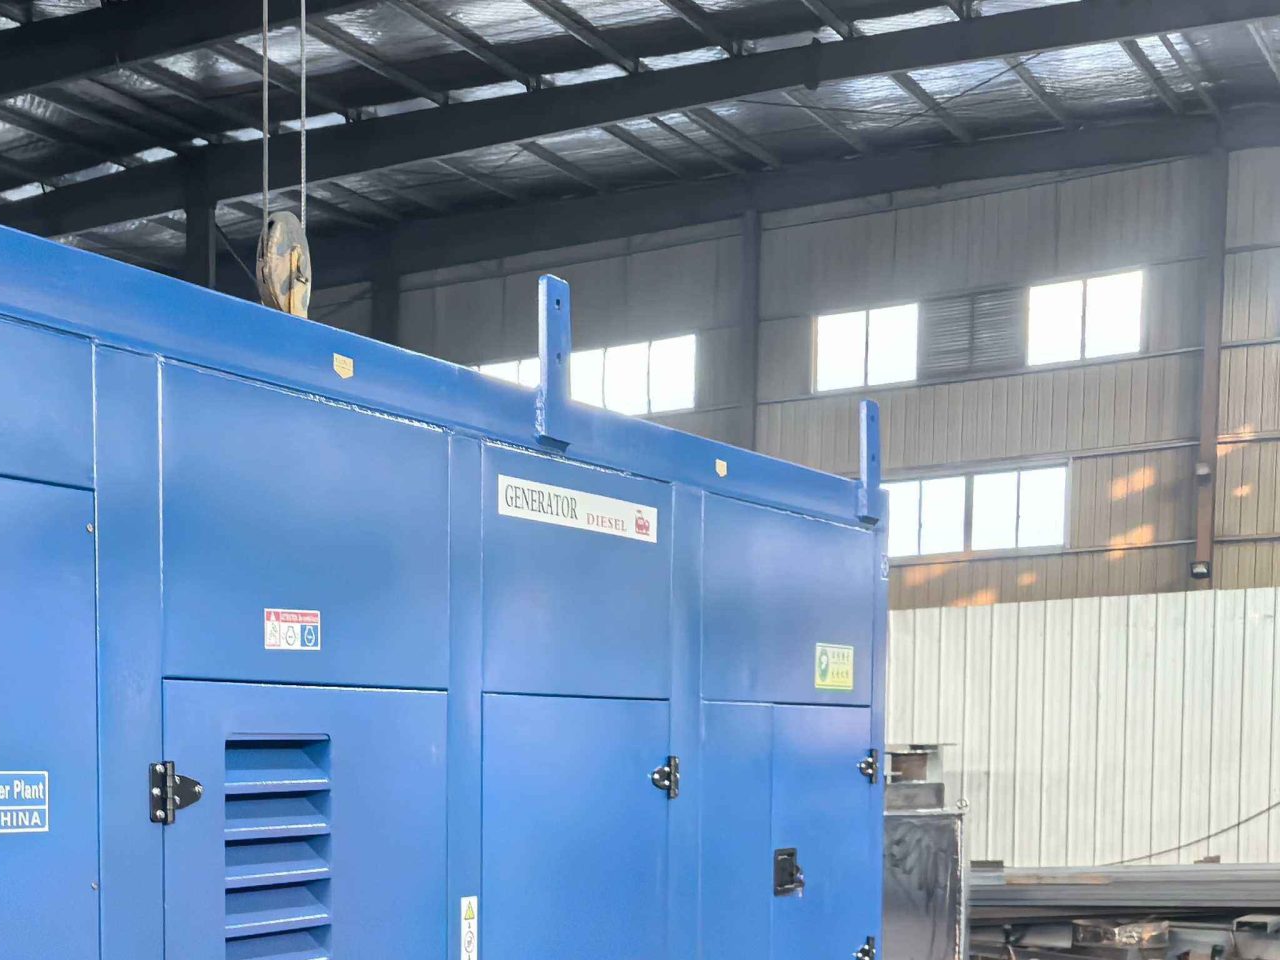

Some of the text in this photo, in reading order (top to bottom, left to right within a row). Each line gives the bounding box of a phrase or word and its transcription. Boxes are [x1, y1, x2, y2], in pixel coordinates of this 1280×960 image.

[505, 484, 627, 532] GENERATOR DIESEL
[13, 780, 44, 799] Plant
